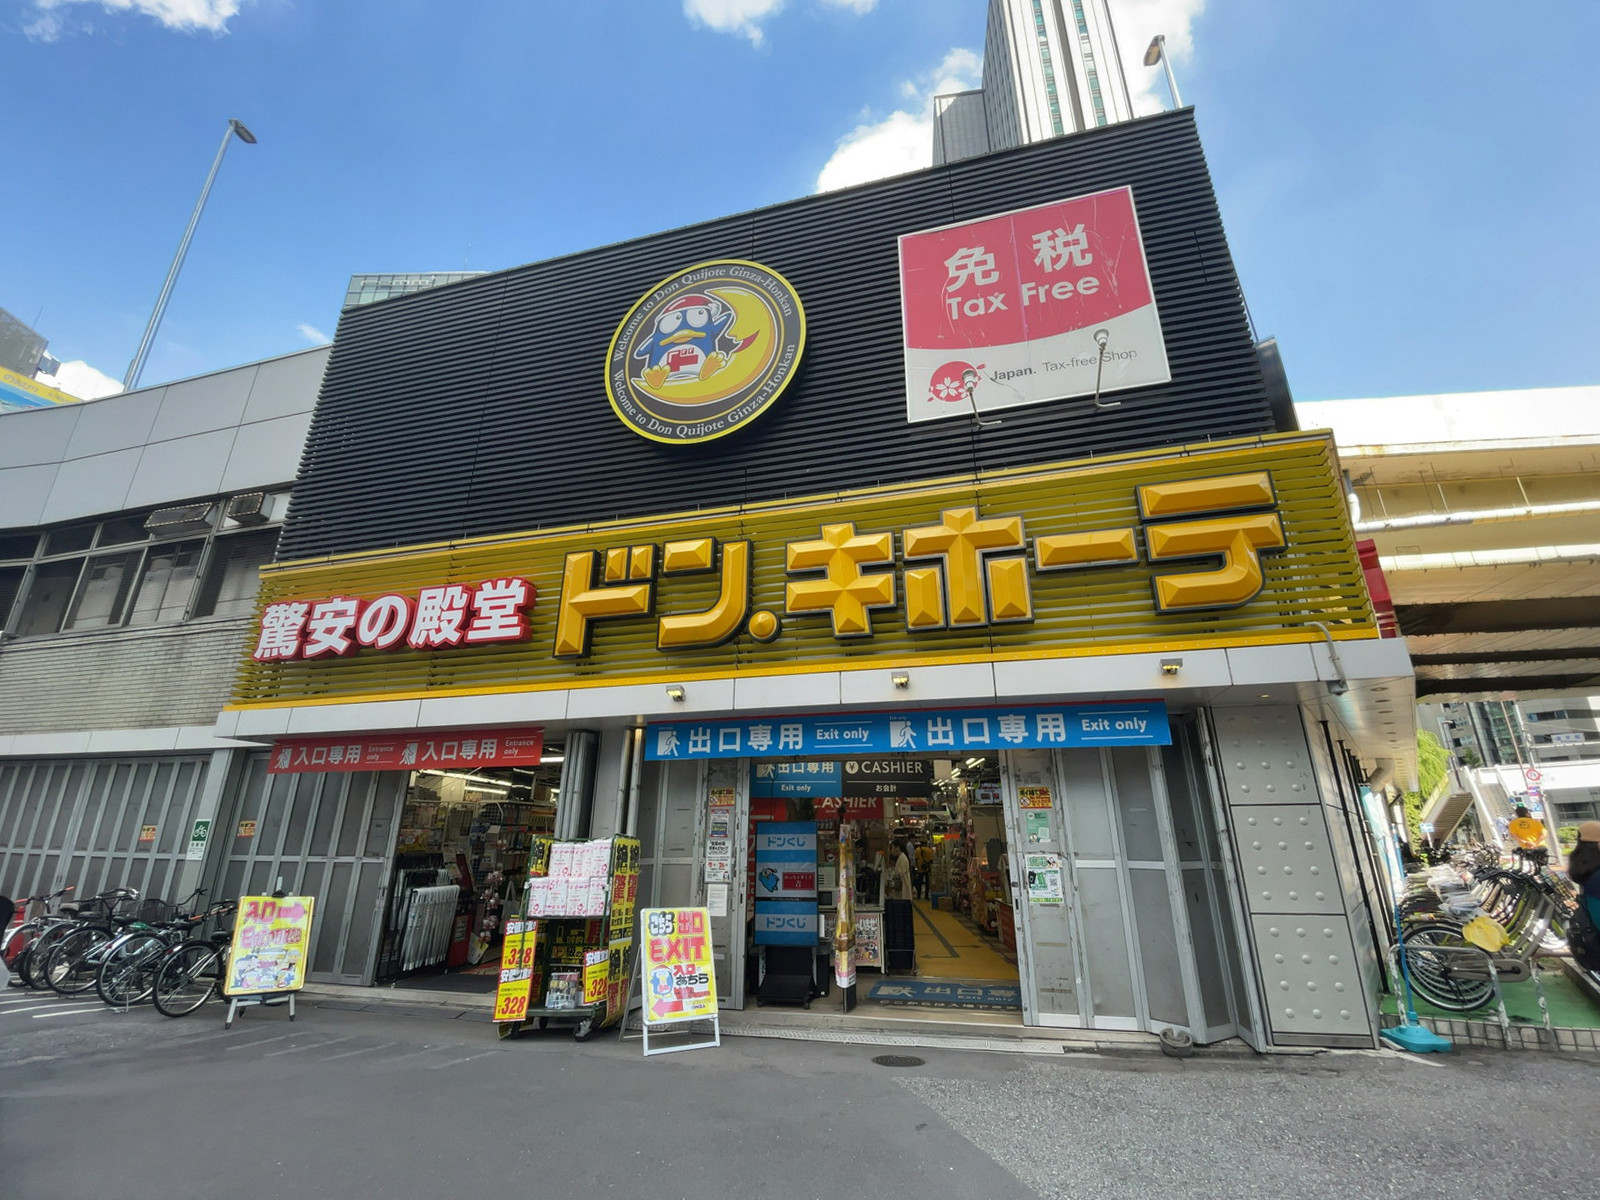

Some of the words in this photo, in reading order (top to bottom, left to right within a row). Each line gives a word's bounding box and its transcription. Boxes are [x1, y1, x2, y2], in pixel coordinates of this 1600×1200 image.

[944, 224, 1093, 292] 免税
[946, 292, 1008, 320] Tax
[1021, 276, 1100, 306] Free
[613, 311, 643, 362] Welcome
[643, 301, 654, 313] to
[655, 282, 679, 302] Don
[681, 267, 726, 286] Quijote
[729, 265, 792, 317] Ginza-Honkan
[990, 366, 1037, 381] Japan.
[1042, 355, 1098, 372] Tax-free
[1101, 348, 1137, 363] Shop
[613, 369, 636, 416] Welcome
[636, 413, 648, 425] to
[647, 419, 672, 435] Don
[676, 420, 725, 438] Quijote
[727, 344, 796, 423] Ginza-Honkan
[253, 577, 532, 662] 驚安の殿堂
[688, 723, 803, 754] 出口専用
[816, 727, 839, 741] Exit
[843, 726, 869, 743] only
[927, 713, 1067, 746] 出口専用
[1081, 718, 1110, 731] Exit
[1115, 717, 1147, 733] only
[368, 745, 394, 753] Entrance
[421, 738, 497, 761] 入口専用
[504, 747, 518, 757] only
[505, 739, 534, 747] Entrance
[294, 745, 361, 765] 入口専用
[366, 753, 380, 761] only
[778, 761, 834, 774] 出口専用
[861, 761, 923, 774] CASHIER
[781, 784, 796, 792] Exit
[797, 784, 811, 793] only
[876, 784, 897, 792] お会計
[814, 797, 877, 808] ASHIER
[767, 836, 806, 847] ドンくじ
[678, 911, 703, 934] 出口
[766, 917, 806, 929] ドンくじ
[649, 937, 706, 962] EXIT
[676, 973, 709, 985] あちら
[501, 995, 526, 1014] 328
